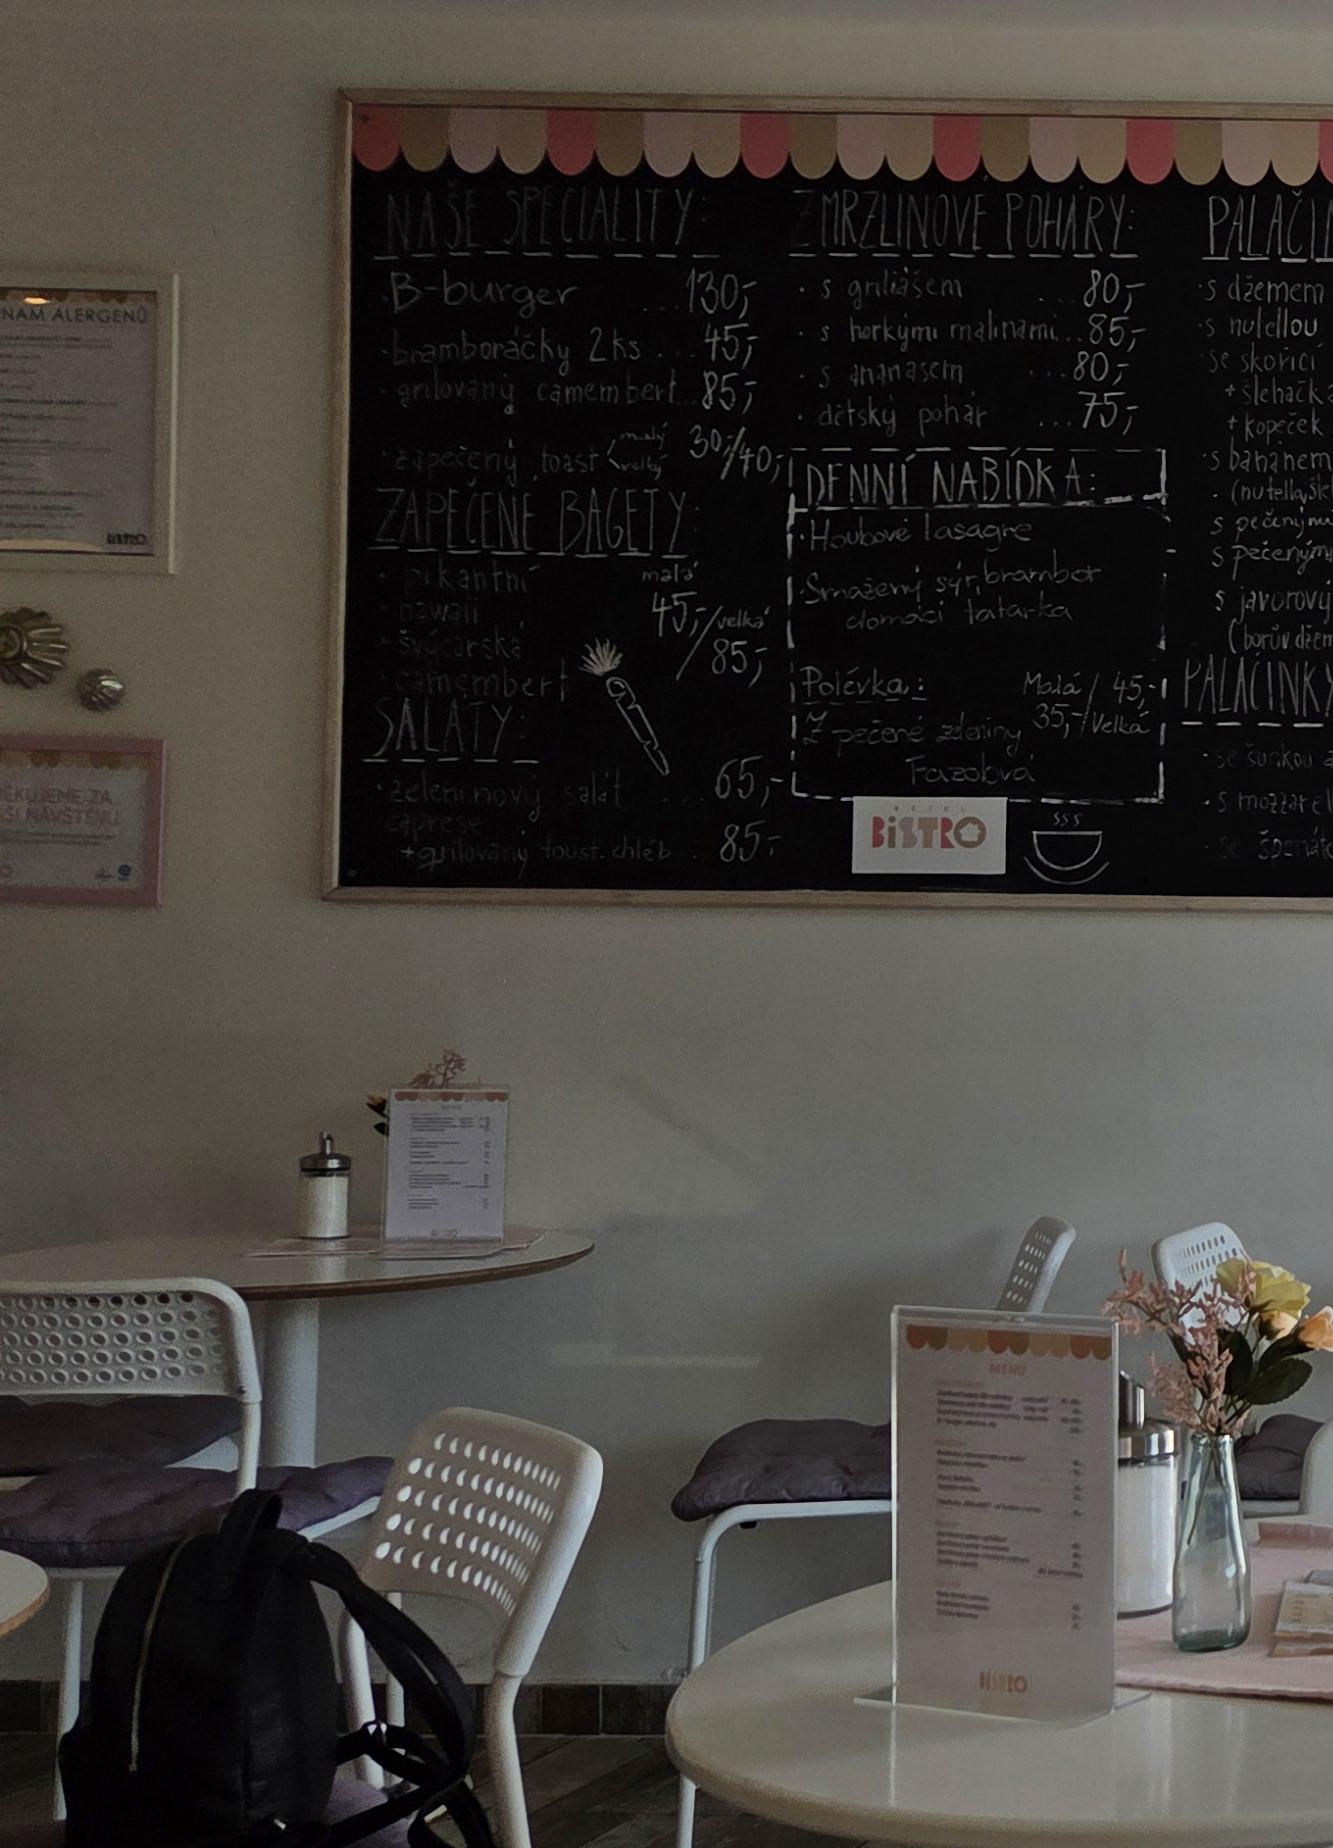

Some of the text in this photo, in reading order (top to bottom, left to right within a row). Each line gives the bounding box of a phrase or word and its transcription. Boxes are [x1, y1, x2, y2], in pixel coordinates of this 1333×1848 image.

[386, 179, 478, 250] NAŠE
[390, 268, 758, 319] B-burger 130,-
[821, 275, 831, 300] s
[1083, 269, 1147, 314] 80,-
[1206, 277, 1217, 302] s
[1228, 273, 1325, 304] džemem
[820, 319, 831, 343] s
[950, 309, 1057, 342] malinami
[1088, 313, 1147, 352] 85,-
[1206, 317, 1216, 338] s
[1229, 305, 1319, 340] nutellou
[590, 326, 607, 362] 2
[614, 328, 641, 362] ks
[704, 323, 760, 369] 45,-
[1208, 350, 1231, 374] se
[818, 351, 1131, 388] s ananasem 80,-
[536, 369, 677, 404] camembert
[702, 370, 758, 414] 85,-
[919, 388, 988, 437] pohár
[1077, 391, 1139, 436] 75,-
[1245, 405, 1324, 445] kopeček
[542, 443, 600, 473] toast
[1210, 450, 1220, 472] s
[806, 453, 916, 504] DENNÍ
[810, 516, 912, 551] Houbové
[1210, 515, 1223, 536] s
[641, 561, 700, 583] malá
[982, 548, 1102, 585] brambor
[1211, 546, 1224, 568] s
[964, 590, 1073, 626] tatarka
[1214, 590, 1225, 612] s
[712, 638, 769, 688] 85,-
[802, 665, 925, 698] Polévka:
[1112, 673, 1157, 709] 45,-
[715, 755, 785, 807] 65,-
[1218, 791, 1228, 812] s
